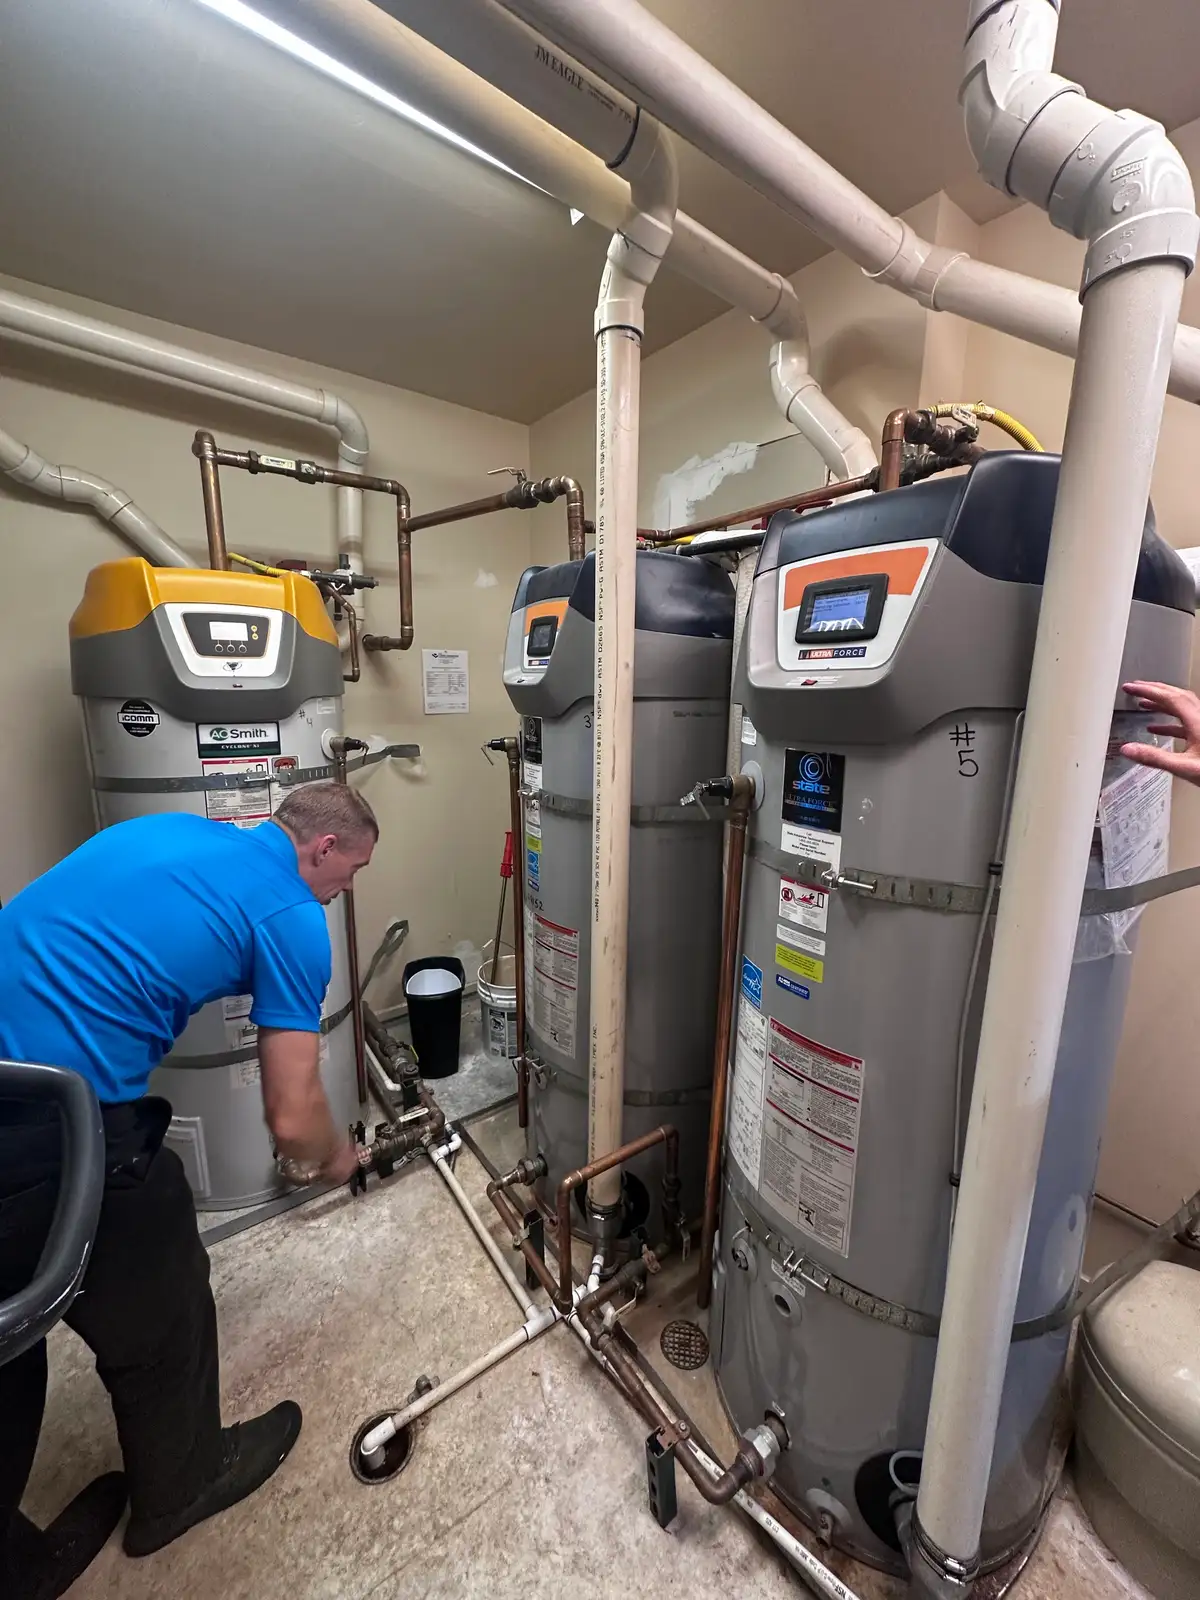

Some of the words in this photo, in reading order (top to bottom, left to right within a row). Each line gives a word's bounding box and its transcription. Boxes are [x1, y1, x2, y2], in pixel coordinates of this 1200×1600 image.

[534, 44, 550, 66] JM
[551, 54, 584, 91] EAGLE
[230, 728, 267, 739] Smith
[957, 748, 979, 778] 5
[792, 780, 831, 795] state
